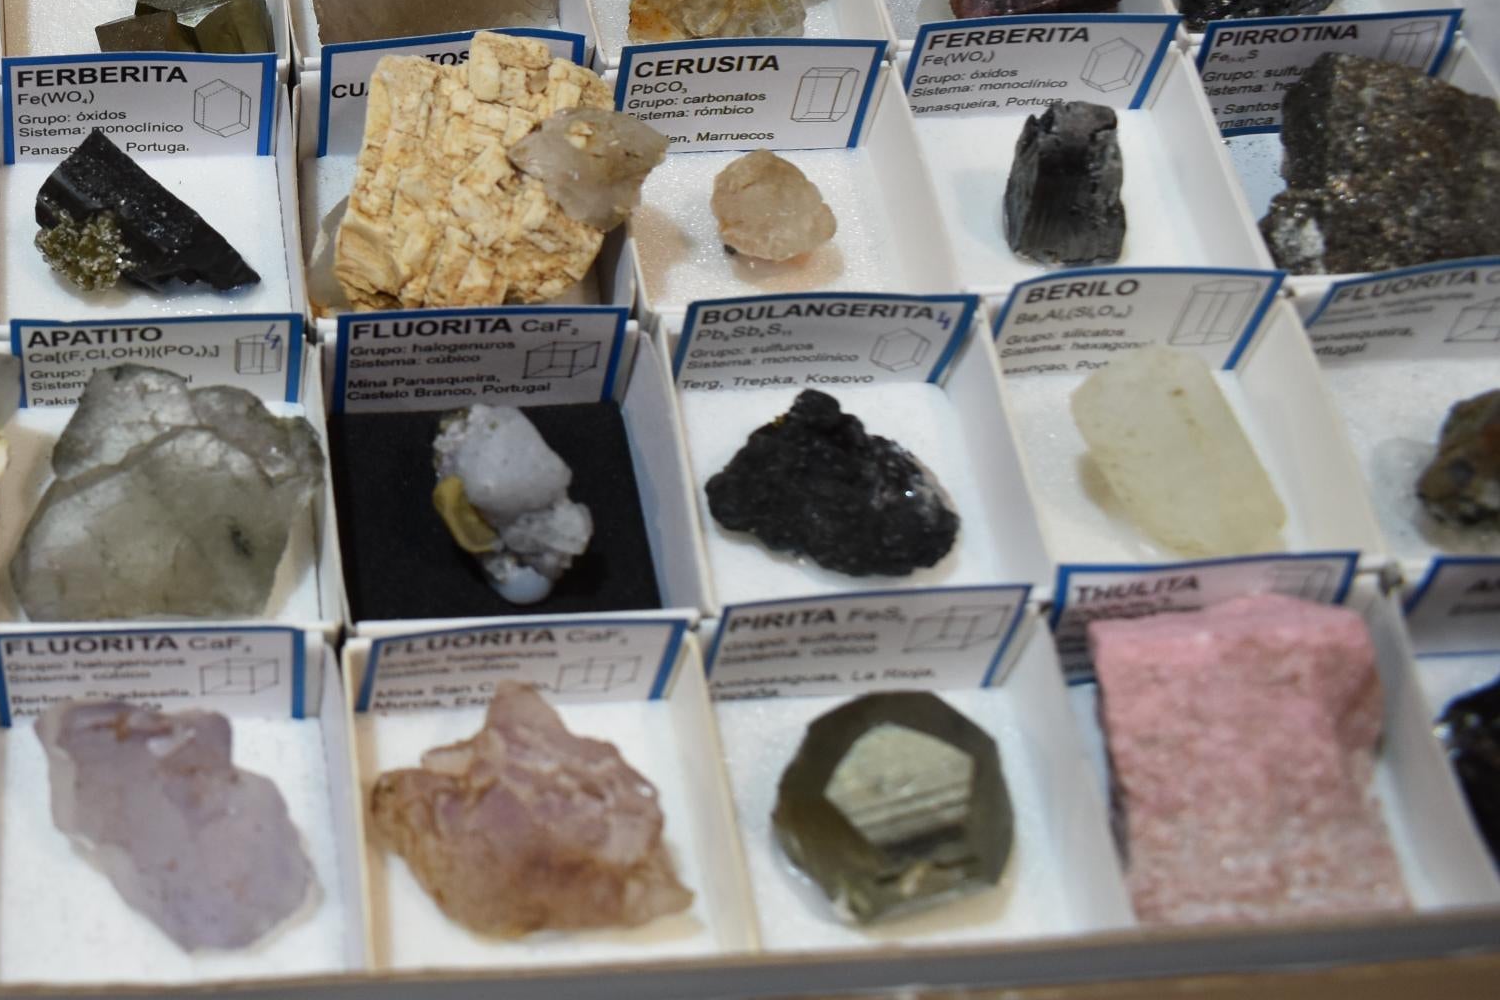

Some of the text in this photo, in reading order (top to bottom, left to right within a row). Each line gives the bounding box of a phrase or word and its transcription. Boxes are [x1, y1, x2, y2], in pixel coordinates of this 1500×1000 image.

[928, 26, 1090, 50] FERBERITA
[1216, 23, 1359, 47] PIRROTINA
[16, 65, 188, 88] FERBERITA
[634, 54, 780, 79] CERUSITA
[979, 78, 1068, 92] monoclínico
[683, 91, 766, 105] carbonatos
[1223, 101, 1279, 115] Santos
[696, 131, 775, 144] Marruecos
[1025, 279, 1140, 304] BERILO
[1336, 270, 1480, 302] FLUORITA
[701, 303, 933, 326] BOULANGERITA
[27, 326, 163, 348] APATITO
[352, 318, 513, 340] FLUORITA
[805, 372, 874, 385] Kosovo
[482, 382, 552, 398] Portugal
[729, 607, 837, 632] PIRITA
[4, 635, 180, 656] FLUORITA
[383, 630, 556, 657] FLUORITA
